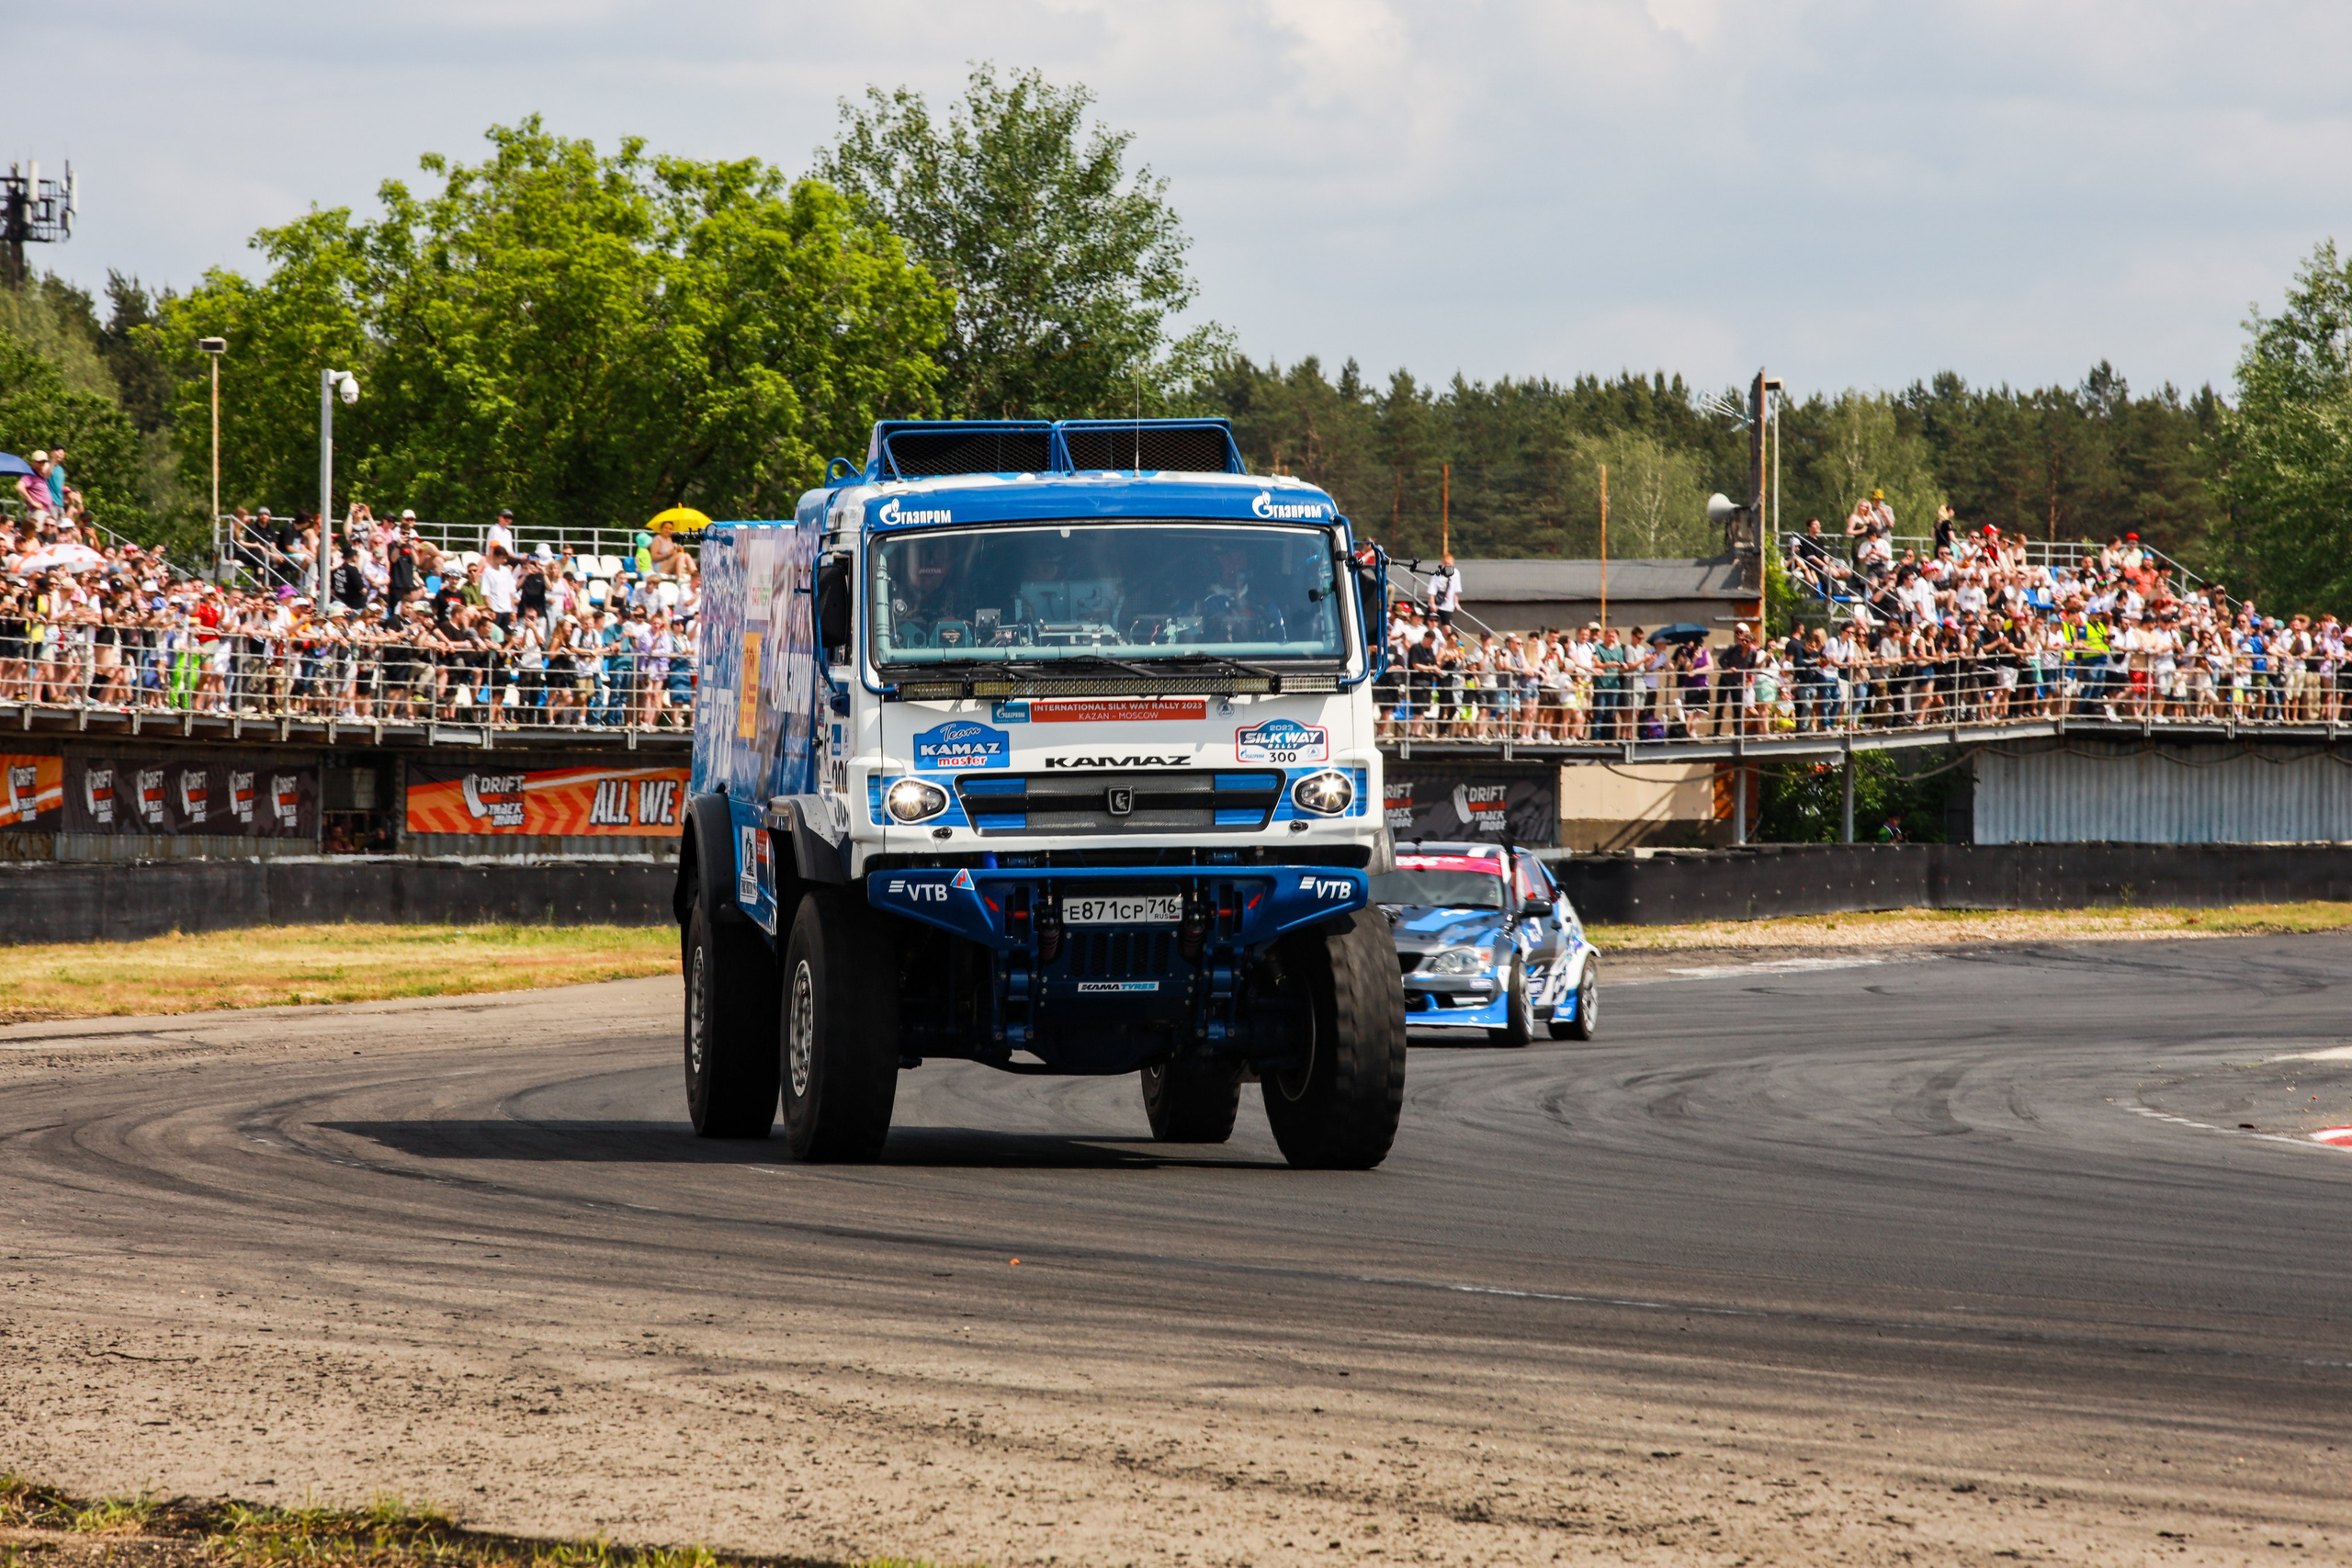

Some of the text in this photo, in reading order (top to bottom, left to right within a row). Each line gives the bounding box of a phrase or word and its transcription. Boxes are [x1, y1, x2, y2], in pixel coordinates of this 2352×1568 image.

[901, 510, 952, 525] ГАЗПРОМ
[1273, 504, 1322, 518] ГАЗПРОМ
[1034, 703, 1106, 712] INTERNATIONAL
[1108, 702, 1127, 710] SILK
[1129, 702, 1149, 710] WAY
[1151, 702, 1180, 710] RALLY
[1079, 712, 1110, 720] KAZAN
[940, 723, 981, 742] Team
[1243, 731, 1321, 744] SILK WAY
[920, 742, 1001, 756] KAMAZ
[938, 755, 988, 767] master
[1045, 755, 1192, 768] KAMAZ
[1269, 751, 1296, 762] 300
[480, 774, 526, 793] DRIFT
[1383, 783, 1414, 799] RIFT
[1469, 785, 1507, 802] DRIFT
[590, 780, 629, 823] ALL
[639, 780, 676, 823] WE
[1475, 810, 1505, 821] TRACK
[906, 884, 948, 902] VTB
[1316, 880, 1351, 899] VTB
[1148, 898, 1177, 914] 716
